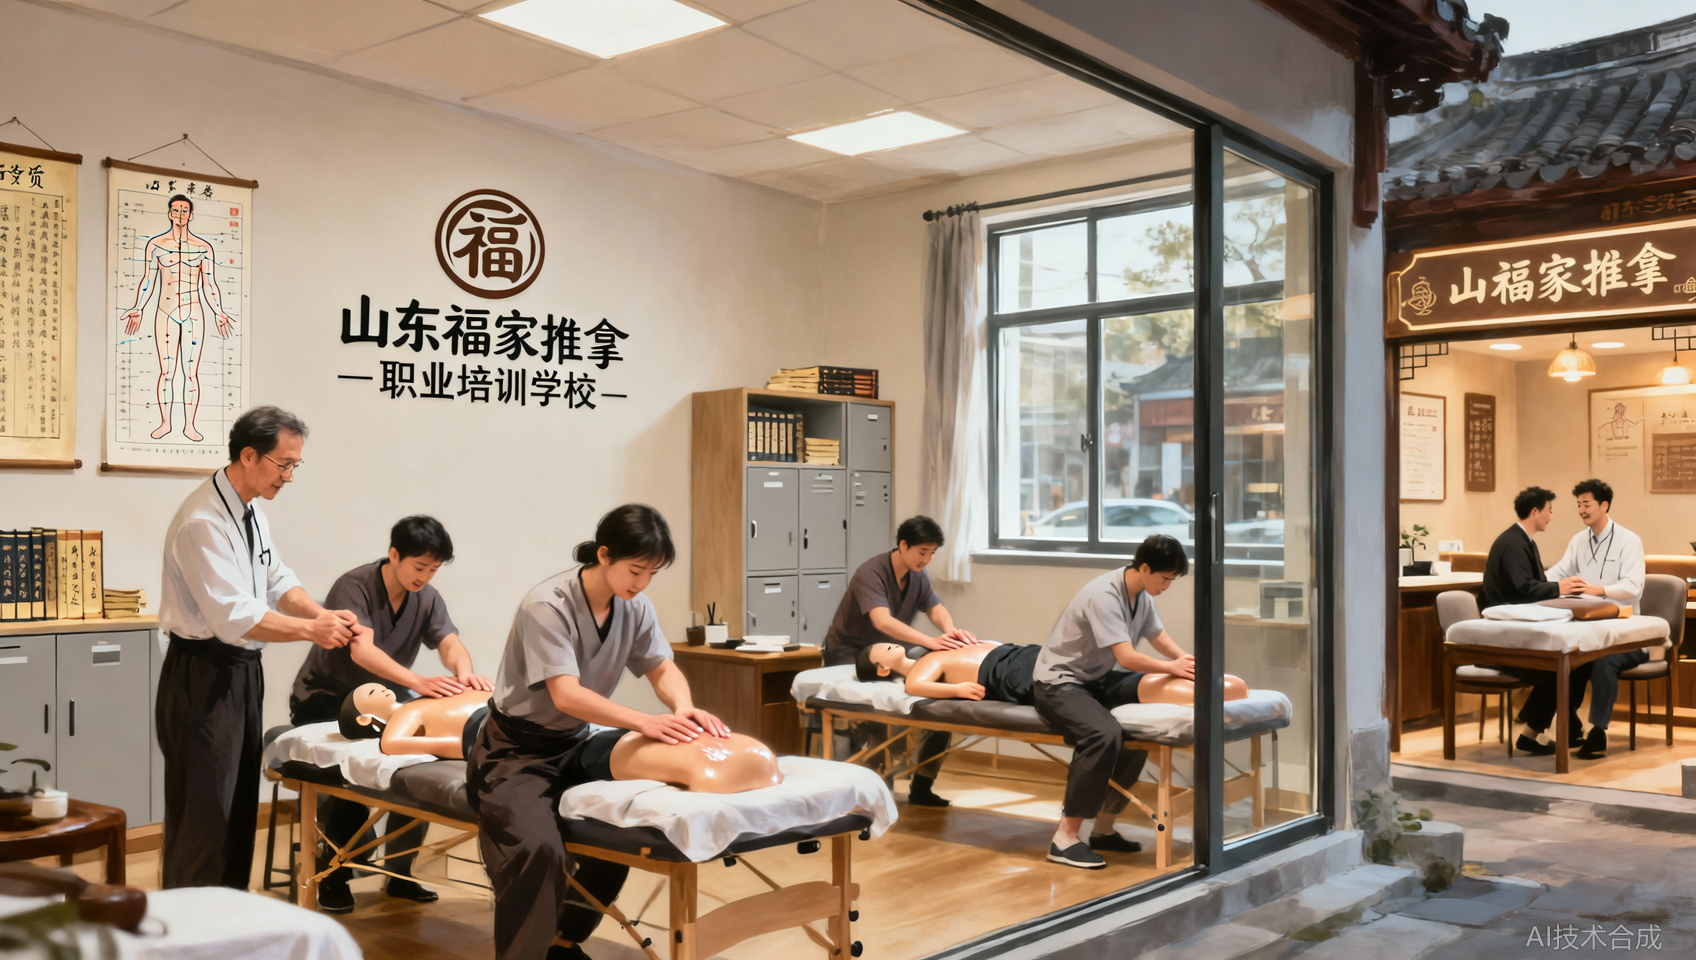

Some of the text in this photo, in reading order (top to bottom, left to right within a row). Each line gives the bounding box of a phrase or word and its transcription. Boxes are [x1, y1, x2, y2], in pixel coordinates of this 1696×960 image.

[453, 211, 528, 284] 福
[1449, 241, 1677, 305] 山福家推拿
[340, 294, 630, 370] 山东福家推拿
